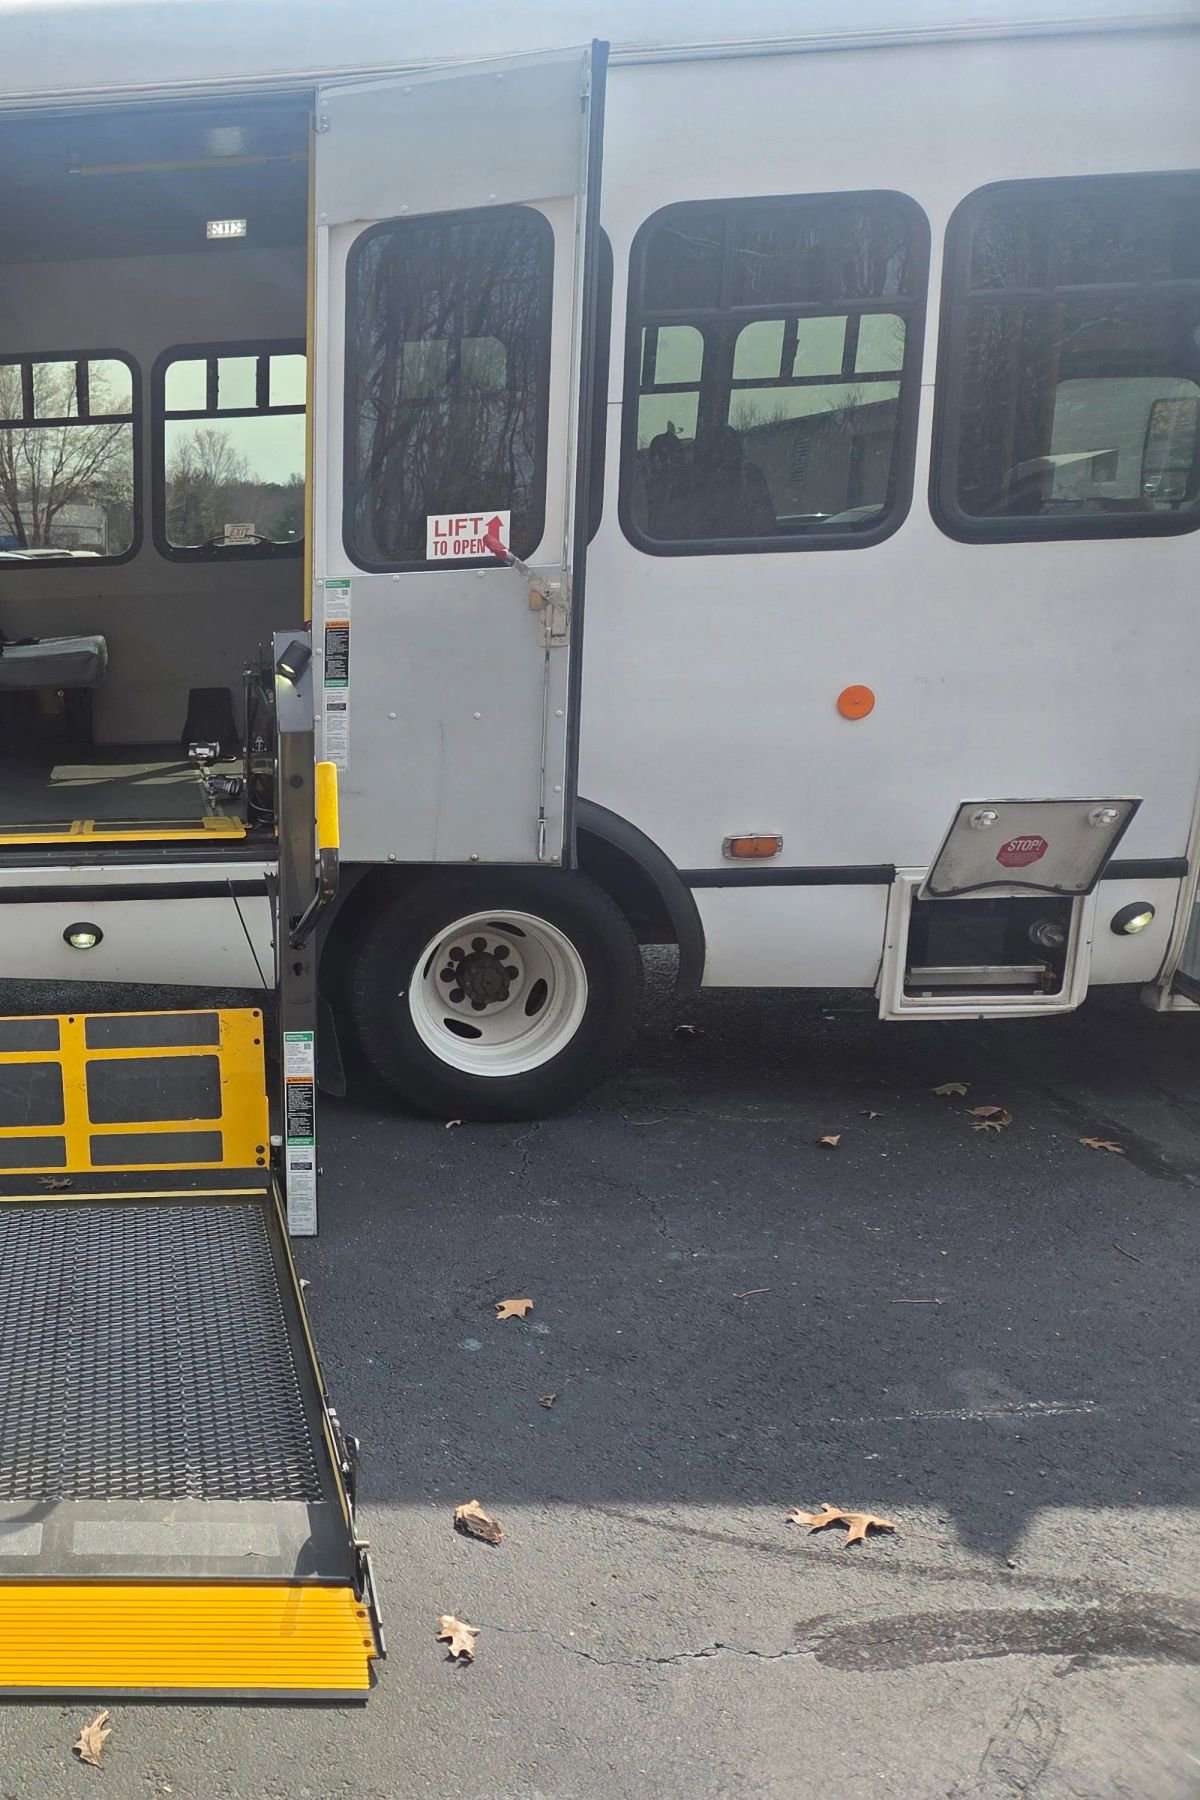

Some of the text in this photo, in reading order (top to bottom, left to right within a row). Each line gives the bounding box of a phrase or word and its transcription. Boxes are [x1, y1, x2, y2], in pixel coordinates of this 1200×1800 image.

[230, 527, 250, 537] EXIT
[434, 517, 484, 537] LIFT
[433, 539, 486, 556] TO OPEN
[1007, 839, 1043, 852] STOP!
